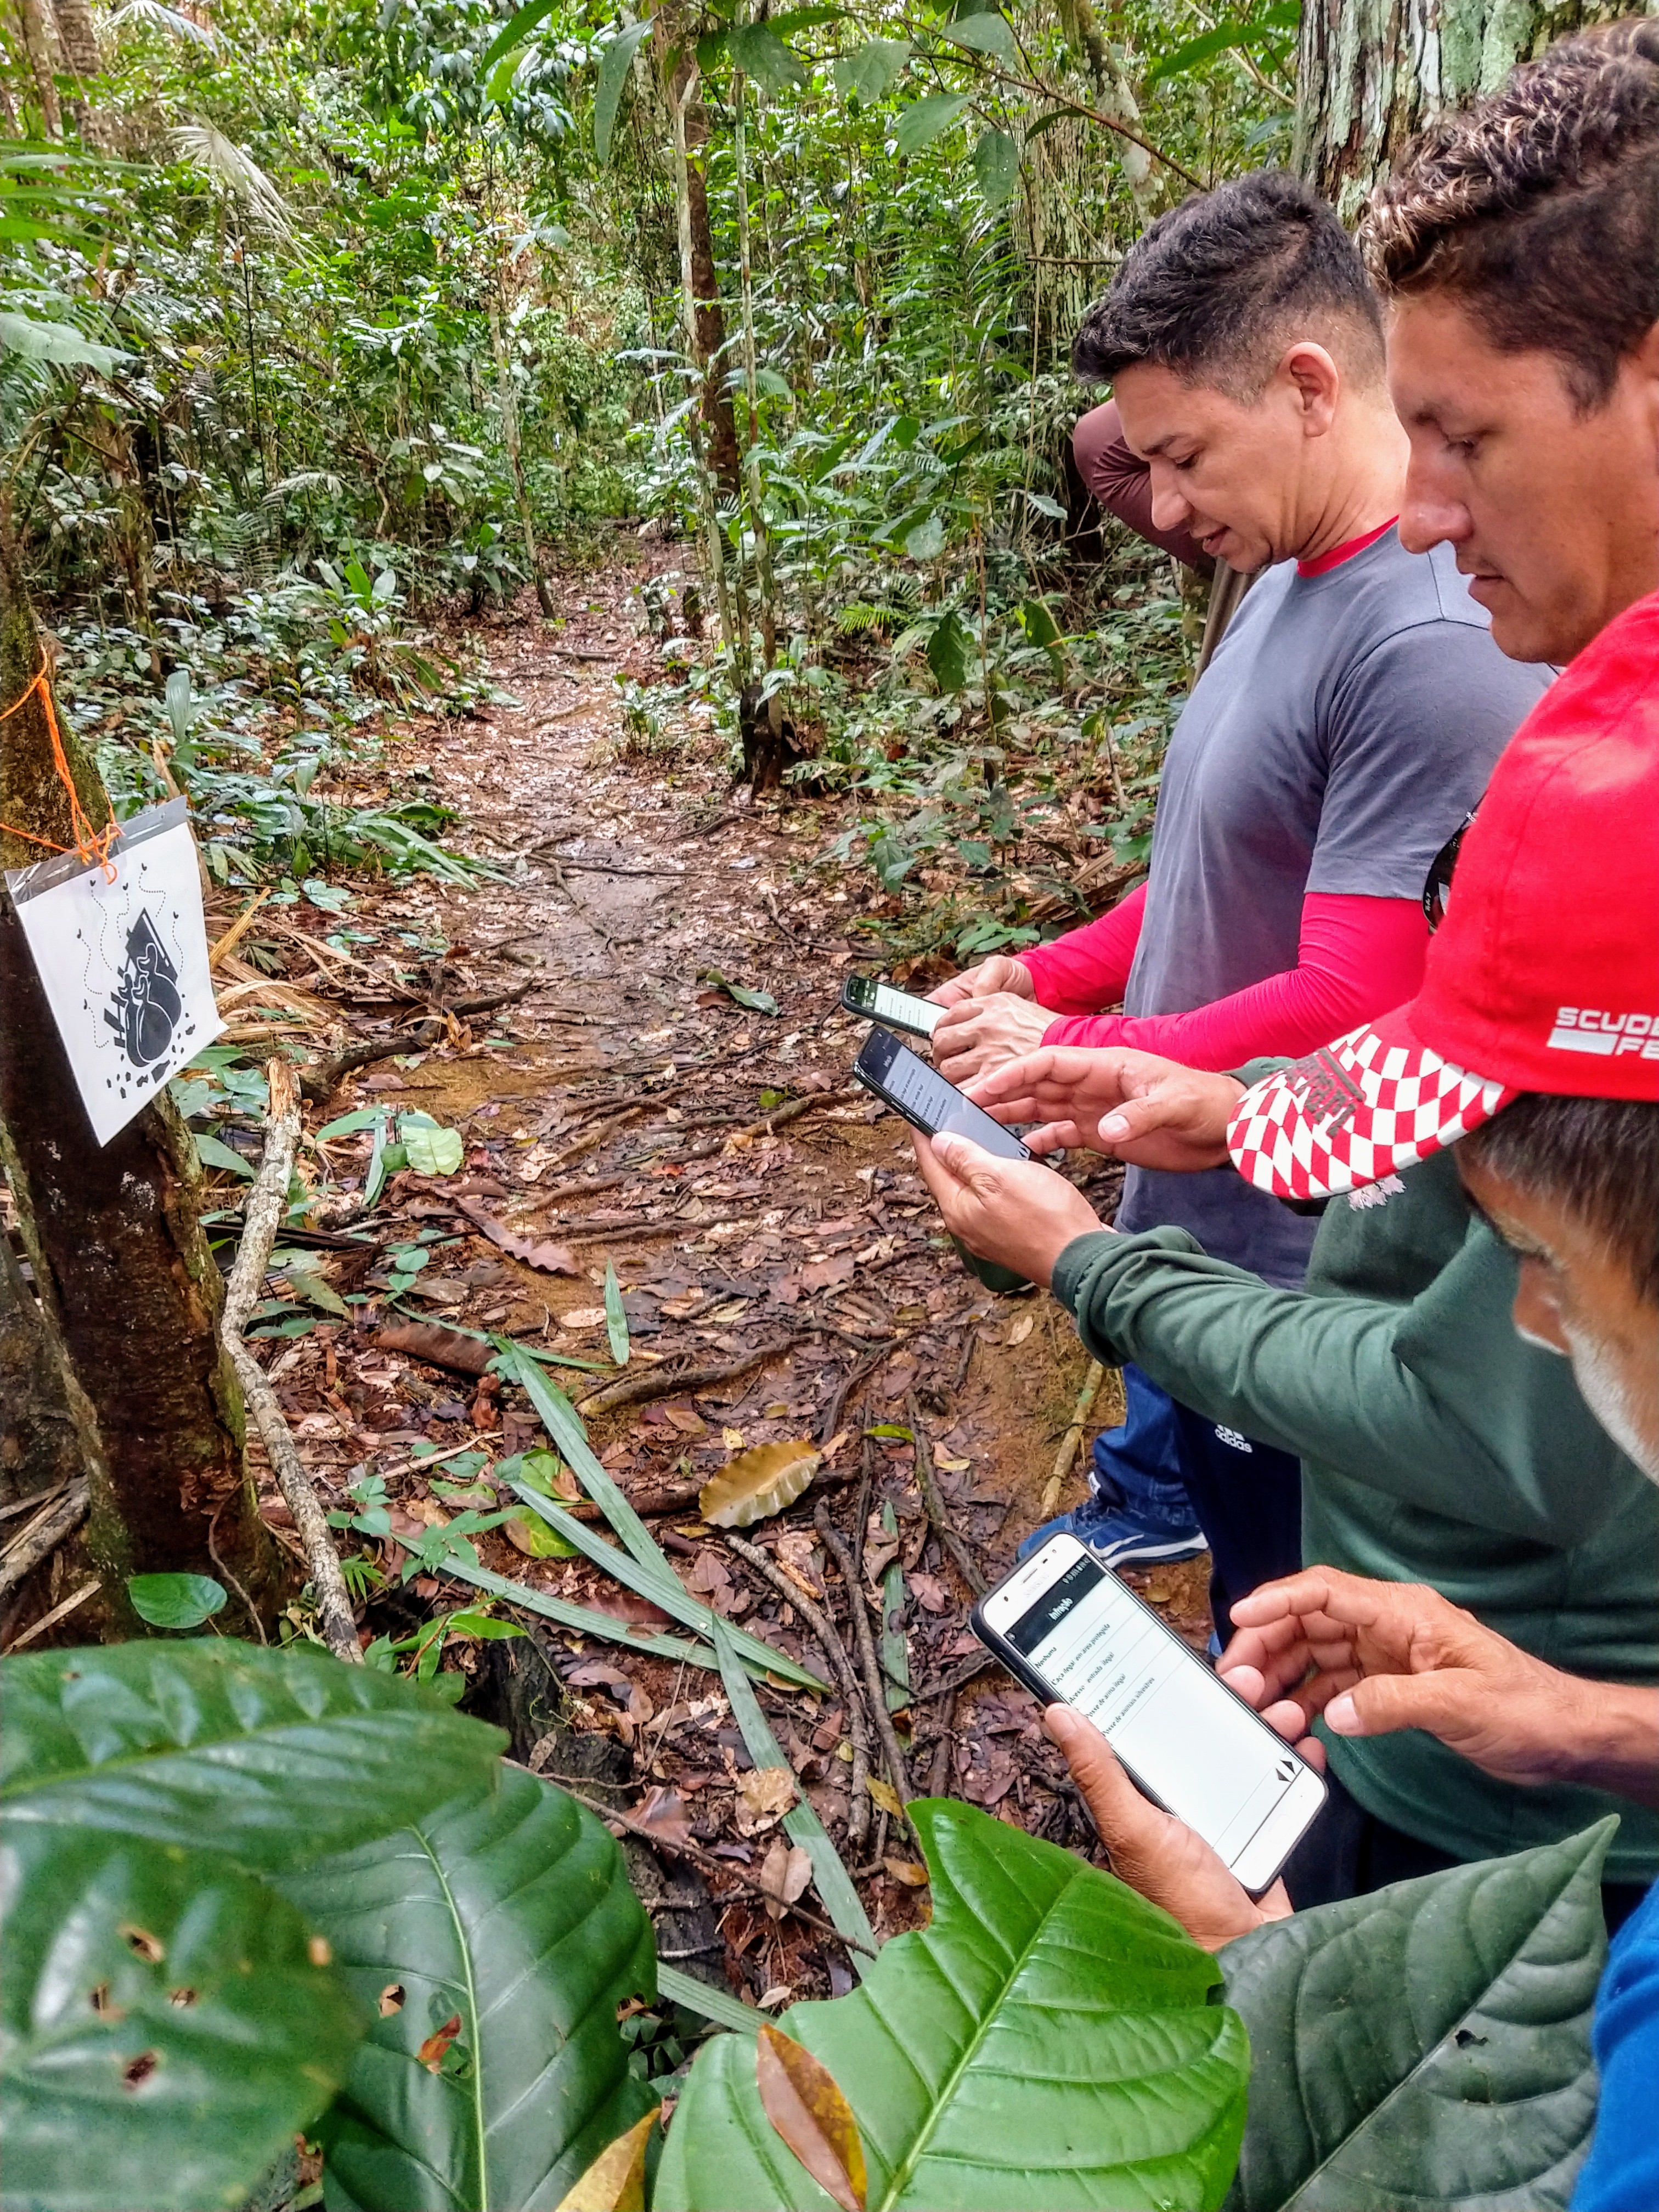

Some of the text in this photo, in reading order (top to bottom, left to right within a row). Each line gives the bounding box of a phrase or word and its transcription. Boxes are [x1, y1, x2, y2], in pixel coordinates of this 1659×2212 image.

[1214, 1428, 1252, 1453] adidas
[1034, 1647, 1057, 1669] Nenhuma
[1063, 1660, 1076, 1674] ilegal
[1091, 1623, 1110, 1645] protegida
[1069, 1651, 1115, 1703] Acesso entrada ilegal
[1098, 1697, 1105, 1706] de
[1104, 1686, 1116, 1700] arma
[1114, 1674, 1126, 1688] ilegal
[1115, 1715, 1122, 1723] de
[1121, 1698, 1137, 1717] animais
[1136, 1677, 1155, 1700] silvestres
